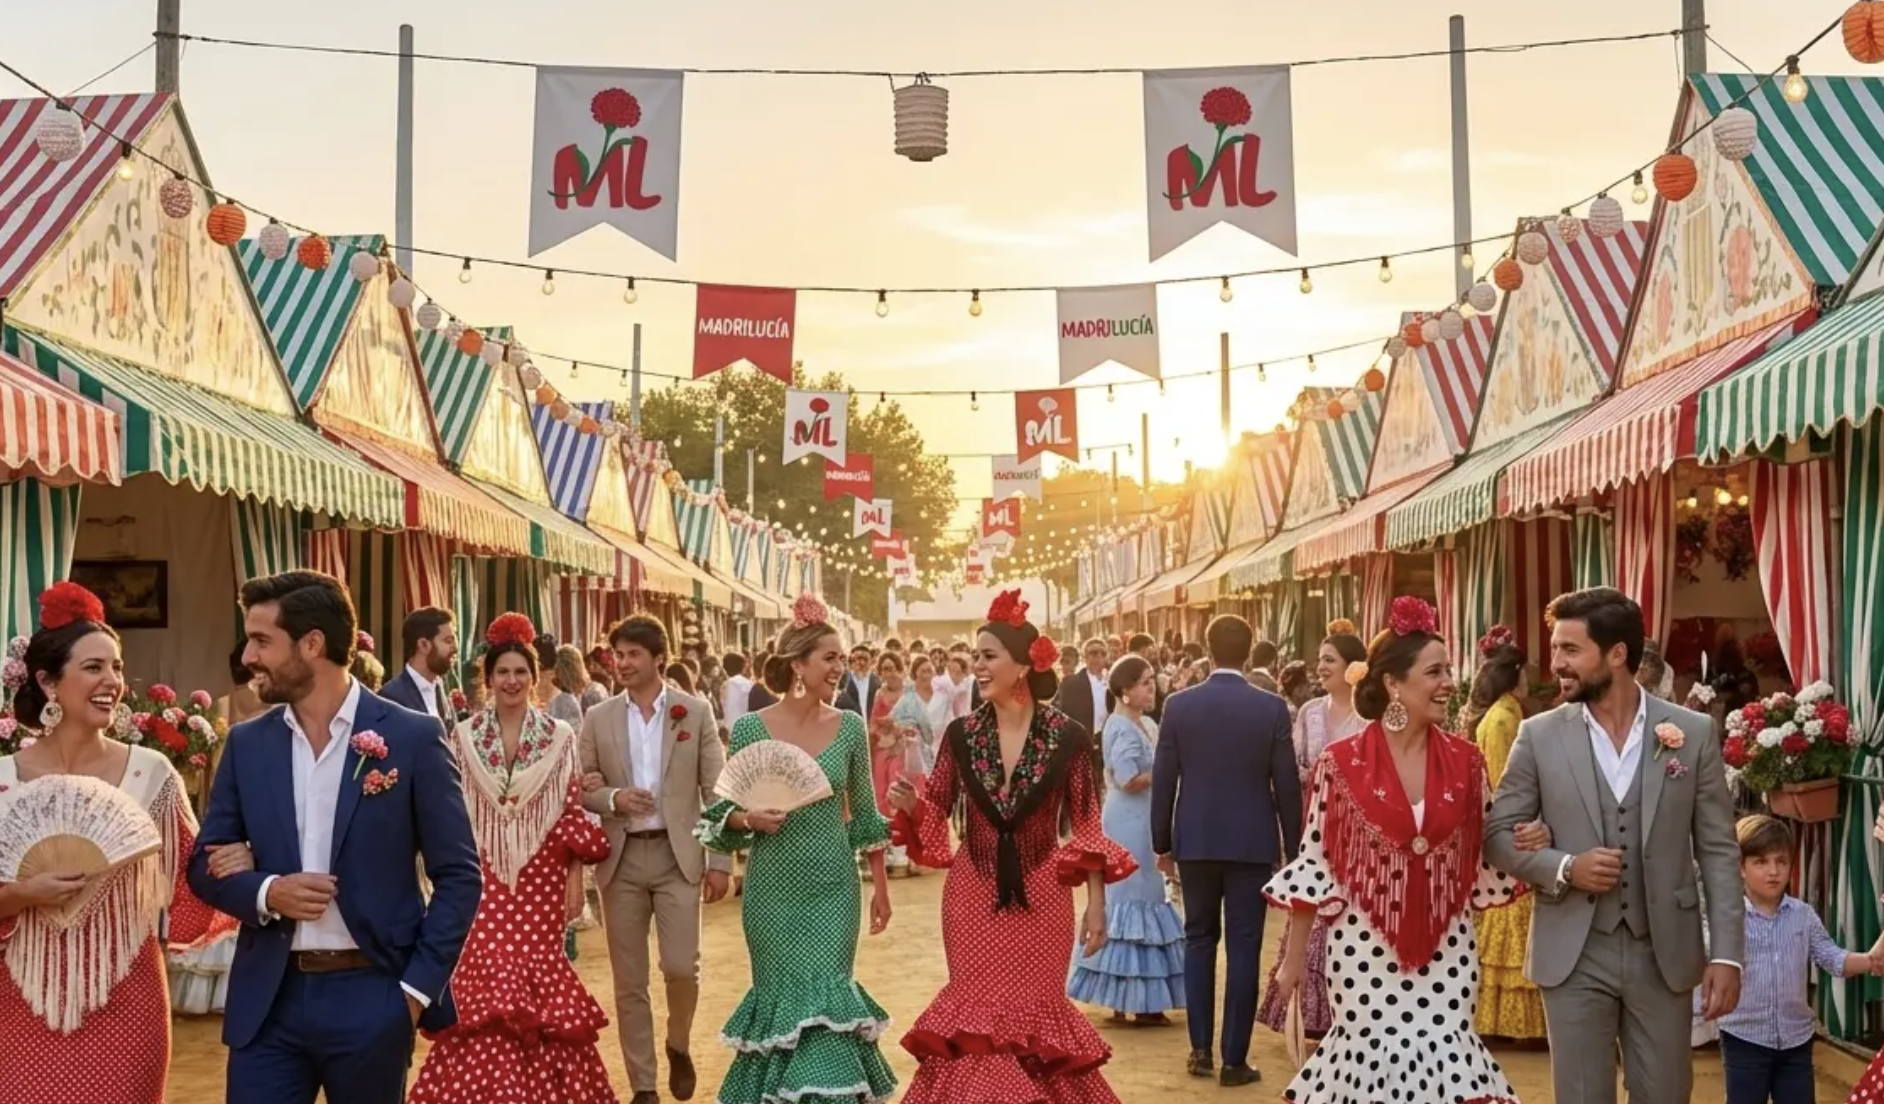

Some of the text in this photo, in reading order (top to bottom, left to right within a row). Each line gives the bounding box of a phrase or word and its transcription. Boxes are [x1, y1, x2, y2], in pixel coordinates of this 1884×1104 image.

[553, 135, 662, 211] ML
[1167, 133, 1278, 211] ML
[699, 317, 790, 338] MADRILUCÍA
[1062, 314, 1154, 338] MADRILUCÍA
[793, 417, 838, 447] ML
[1025, 415, 1072, 447] ML
